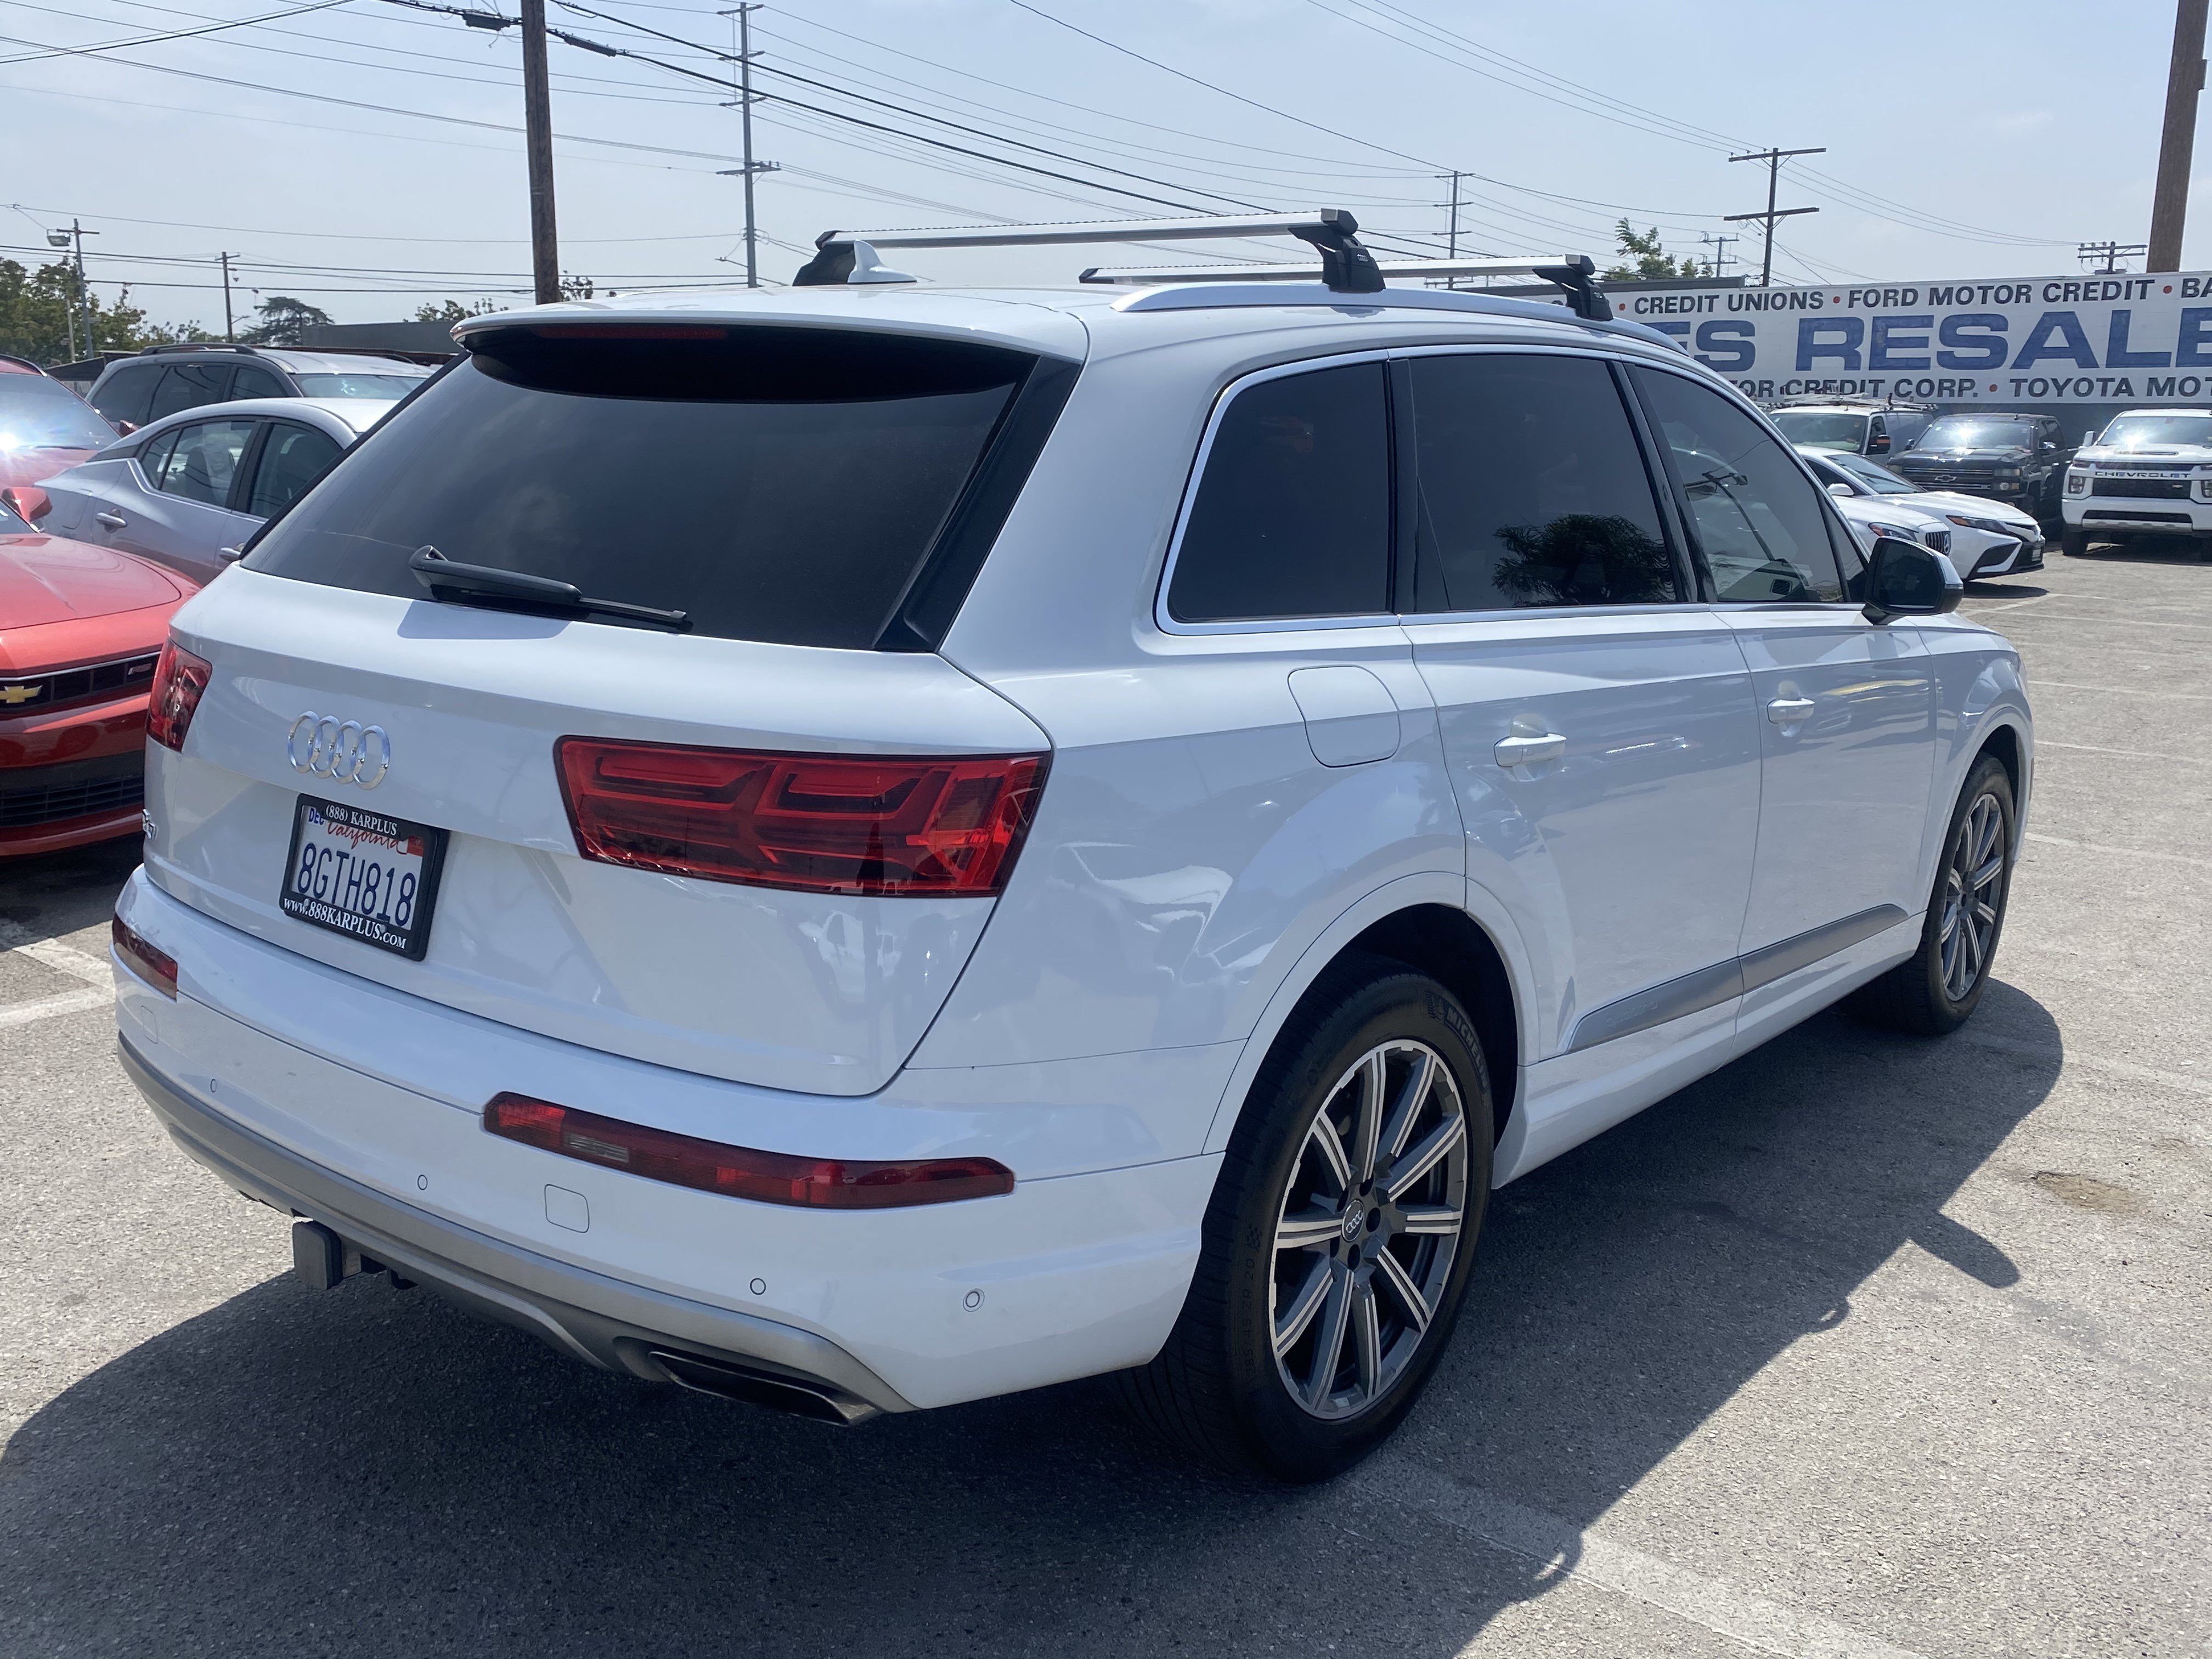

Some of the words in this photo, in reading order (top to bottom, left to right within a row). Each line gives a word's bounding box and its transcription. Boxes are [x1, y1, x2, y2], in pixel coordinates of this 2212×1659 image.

[1634, 295, 1719, 314] CREDIT
[1728, 291, 1824, 312] UNIONS
[1848, 288, 1919, 308] FORD
[1928, 284, 2033, 306] MOTOR
[2042, 279, 2155, 302] CREDIT
[1729, 380, 1774, 398] OR
[1894, 379, 1979, 398] CORP.
[2010, 377, 2136, 398] TOYOTA
[326, 804, 348, 822] (888)
[351, 811, 397, 836] KARPLUS
[297, 842, 416, 927] 8GTH818
